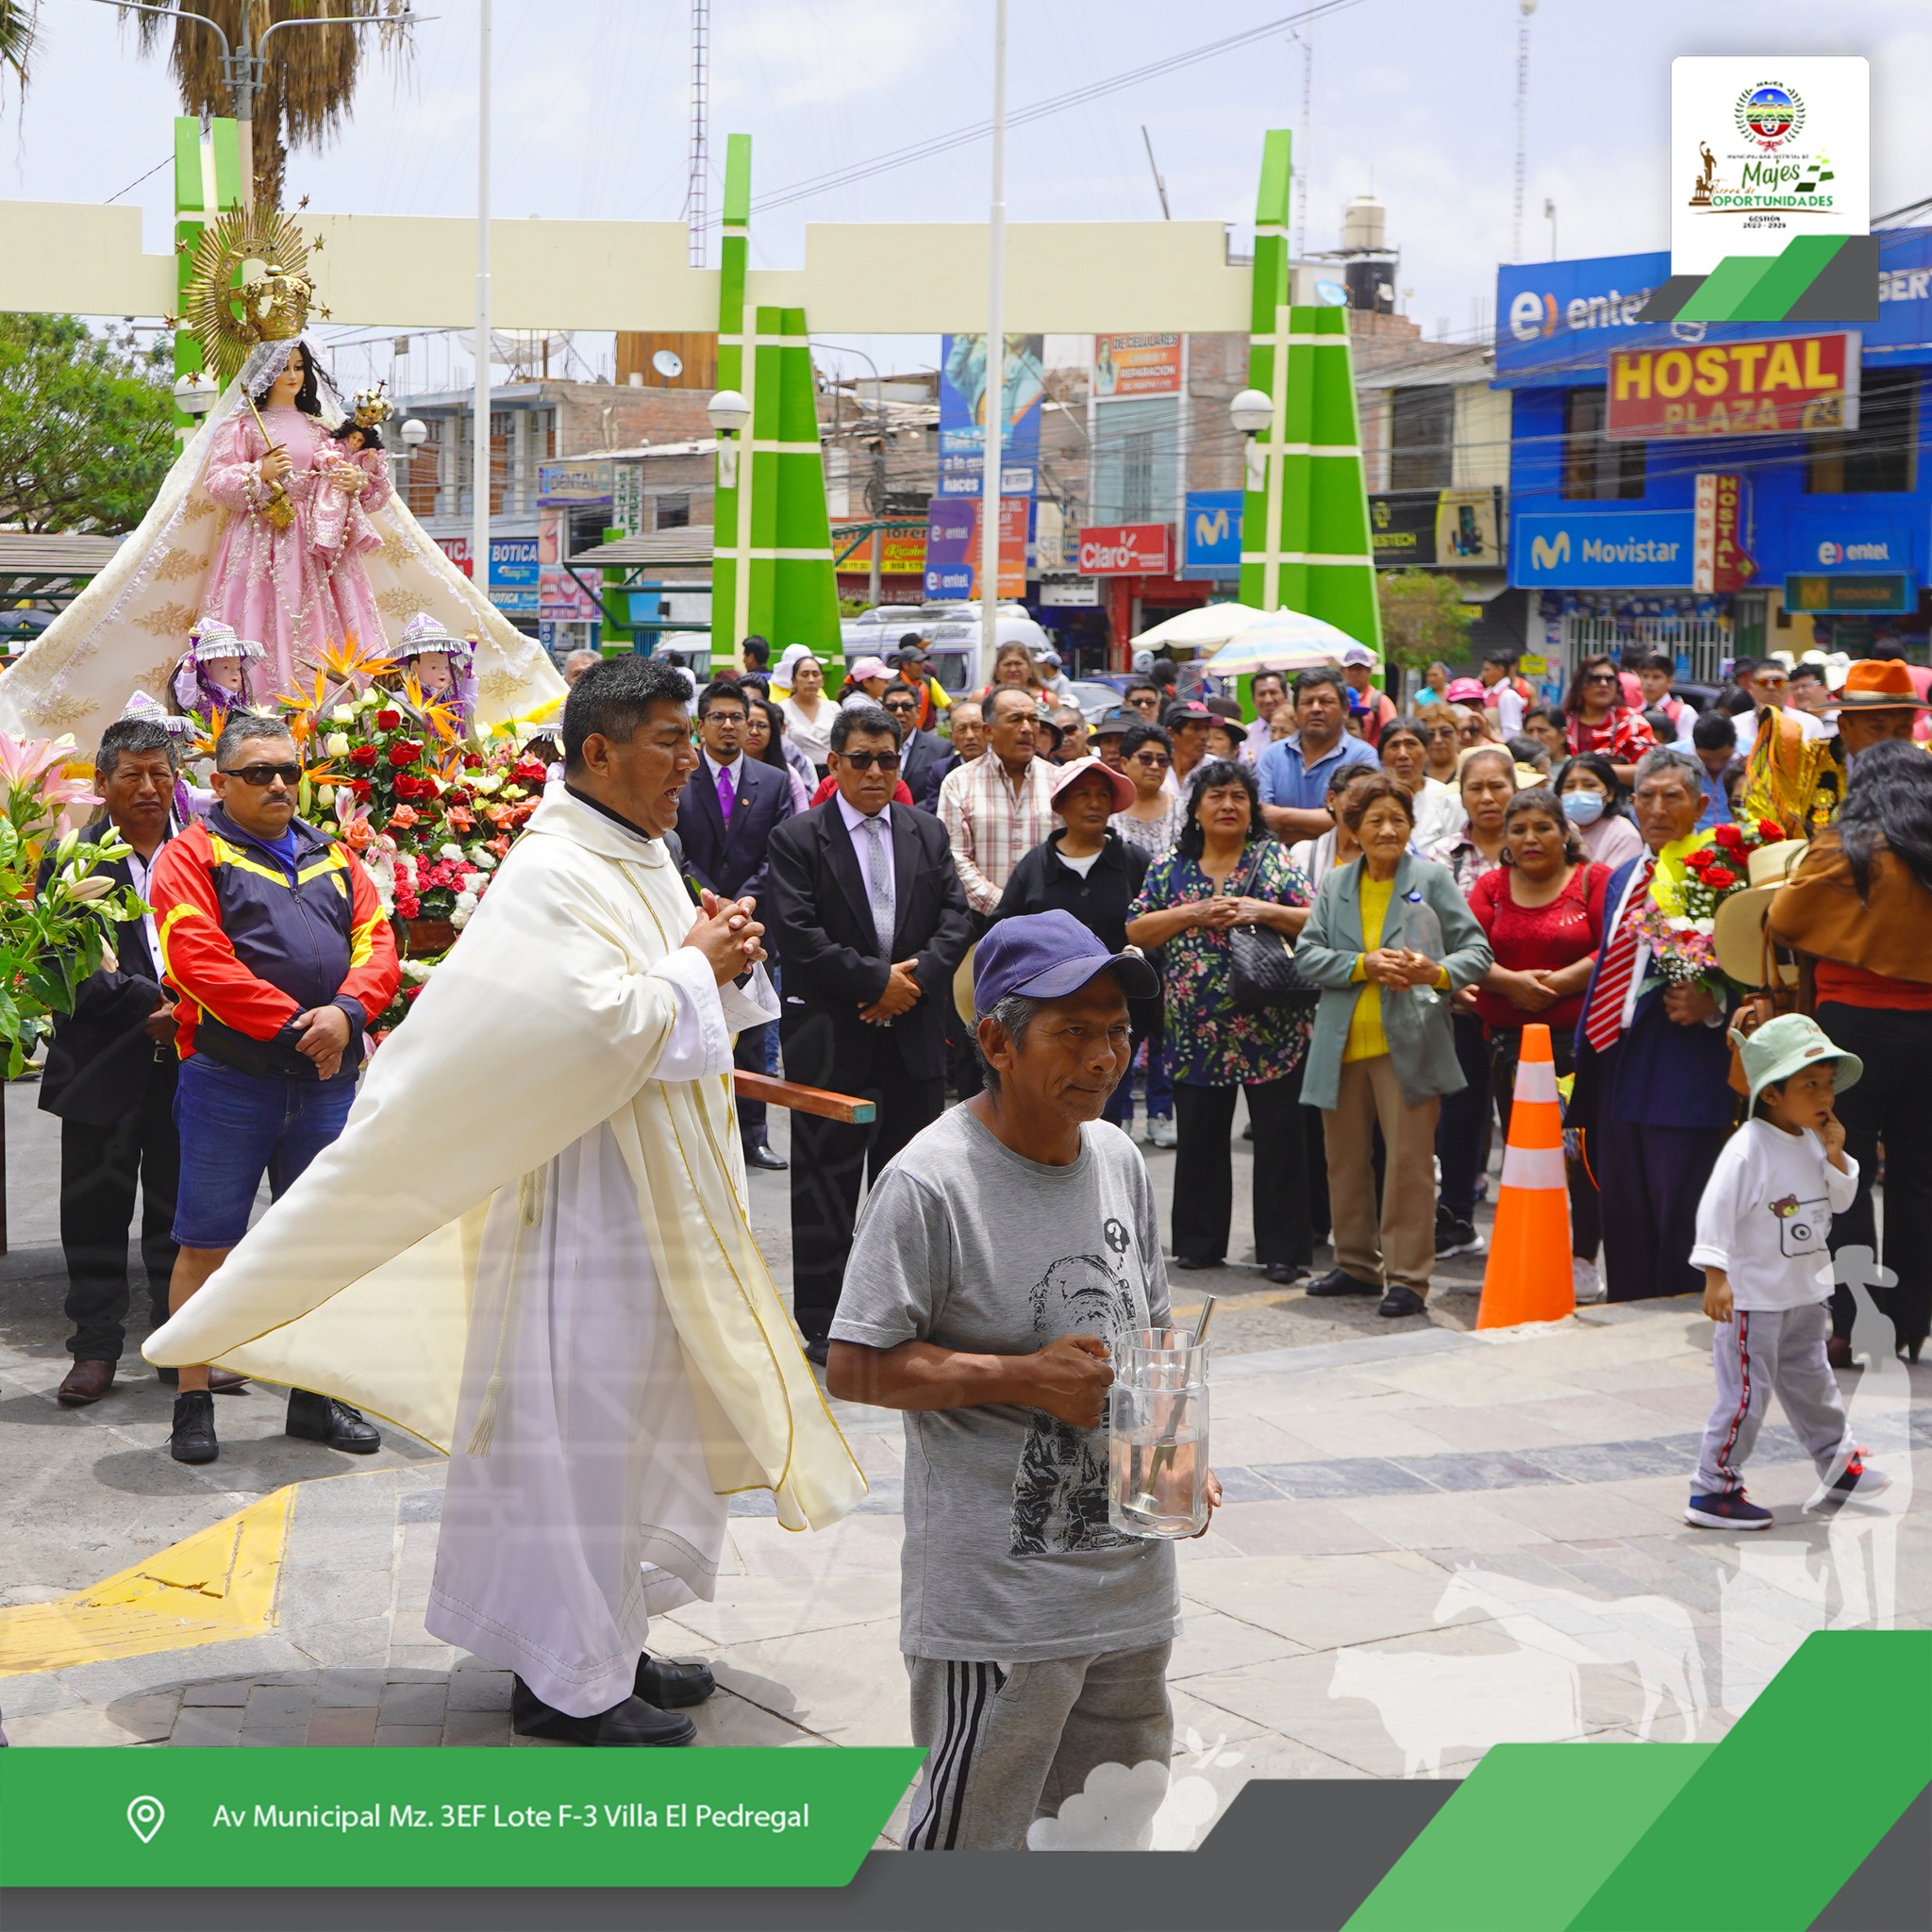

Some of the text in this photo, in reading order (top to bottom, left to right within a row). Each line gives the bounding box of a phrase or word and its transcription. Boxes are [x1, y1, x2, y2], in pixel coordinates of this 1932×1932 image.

[1616, 341, 1838, 402] HOSTAL
[1663, 397, 1782, 436] PLAZA
[551, 472, 599, 491] DENTAL
[1699, 476, 1713, 592] HOSTAL
[1716, 476, 1737, 570] HOSTAL
[491, 543, 538, 563] BOTICA
[1080, 542, 1130, 570] Claro
[1582, 536, 1680, 564] Movistar
[1846, 542, 1890, 562] entel
[943, 574, 969, 589] entel
[1833, 586, 1892, 601] movistar
[489, 591, 519, 604] BOTICA
